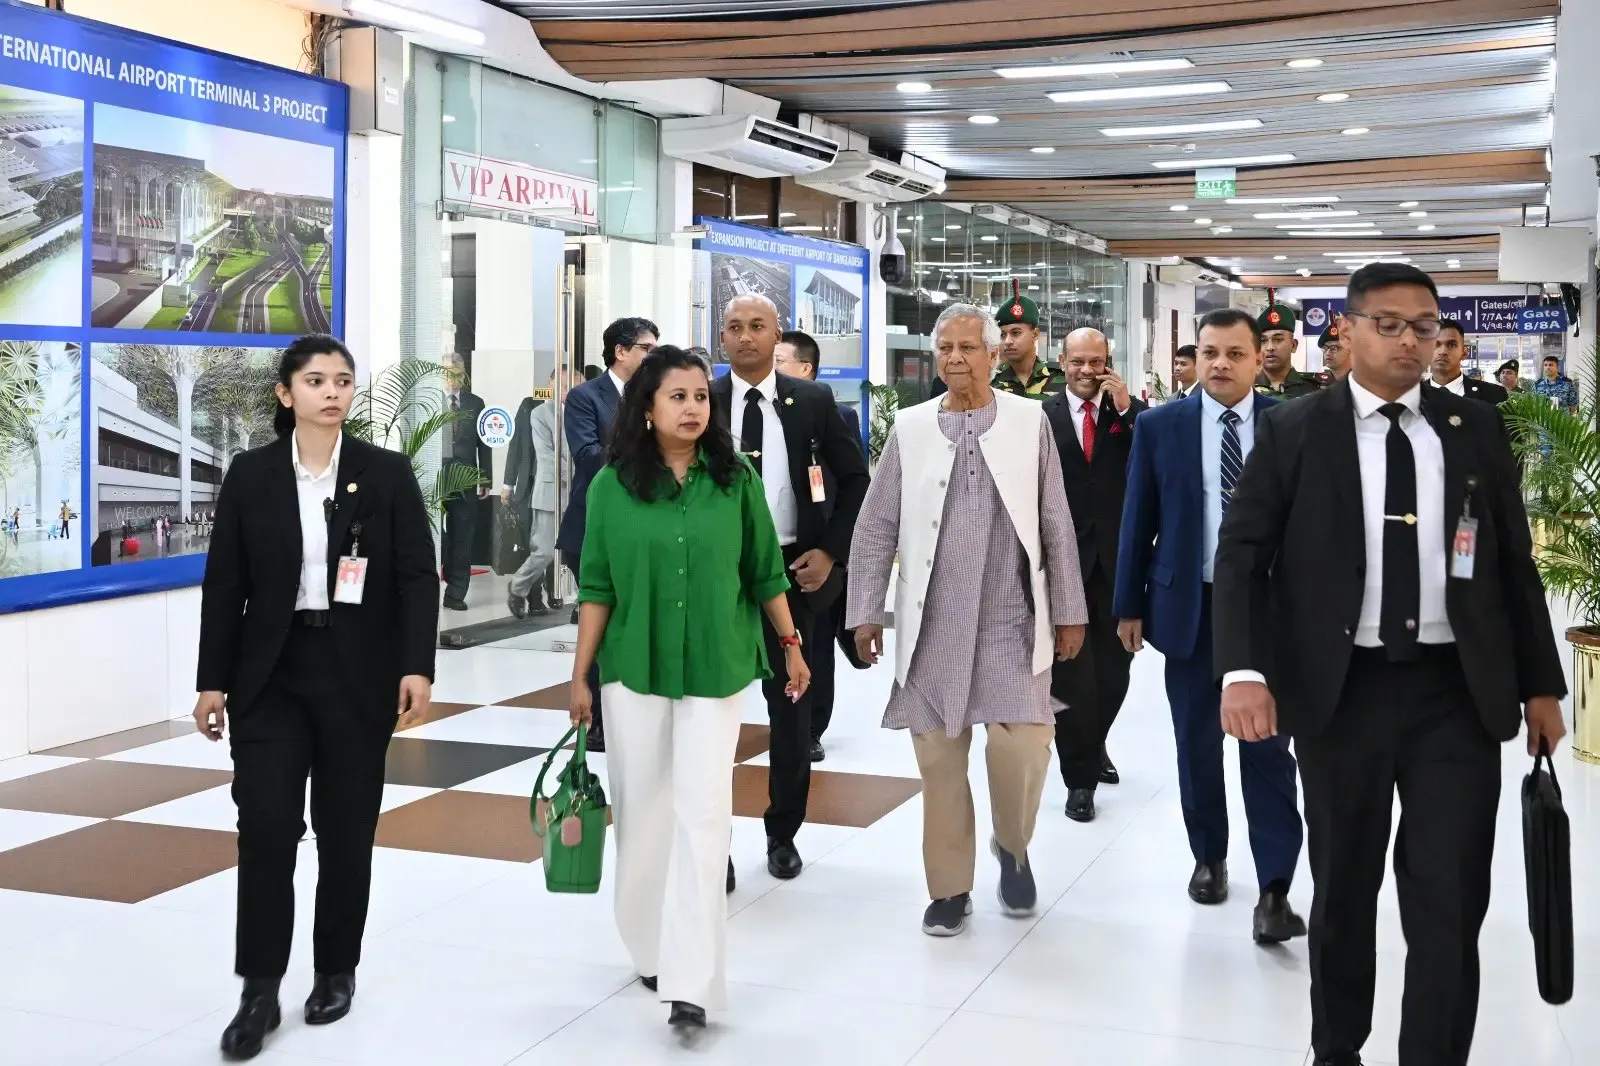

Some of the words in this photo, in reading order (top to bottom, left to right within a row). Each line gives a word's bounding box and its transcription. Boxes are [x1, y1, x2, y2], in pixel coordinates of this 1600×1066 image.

[0, 33, 115, 80] ERNATIONAL
[118, 62, 187, 94] AIRPORT
[188, 78, 260, 111] TERMINAL
[262, 94, 270, 113] 3
[274, 96, 328, 124] PROJECT
[449, 161, 493, 197] VIP
[497, 173, 595, 217] ARRIVAL
[1197, 180, 1222, 189] EXIT
[711, 231, 745, 248] EXPANSION
[745, 236, 769, 252] PROJECT
[769, 241, 777, 253] AT
[777, 242, 804, 257] DIFFERENT
[805, 247, 826, 261] AIRPORT
[1438, 309, 1461, 320] ival
[1523, 310, 1560, 319] Gate
[1523, 320, 1560, 330] 8/8A
[534, 390, 551, 398] PULL
[114, 505, 164, 520] WELCOME
